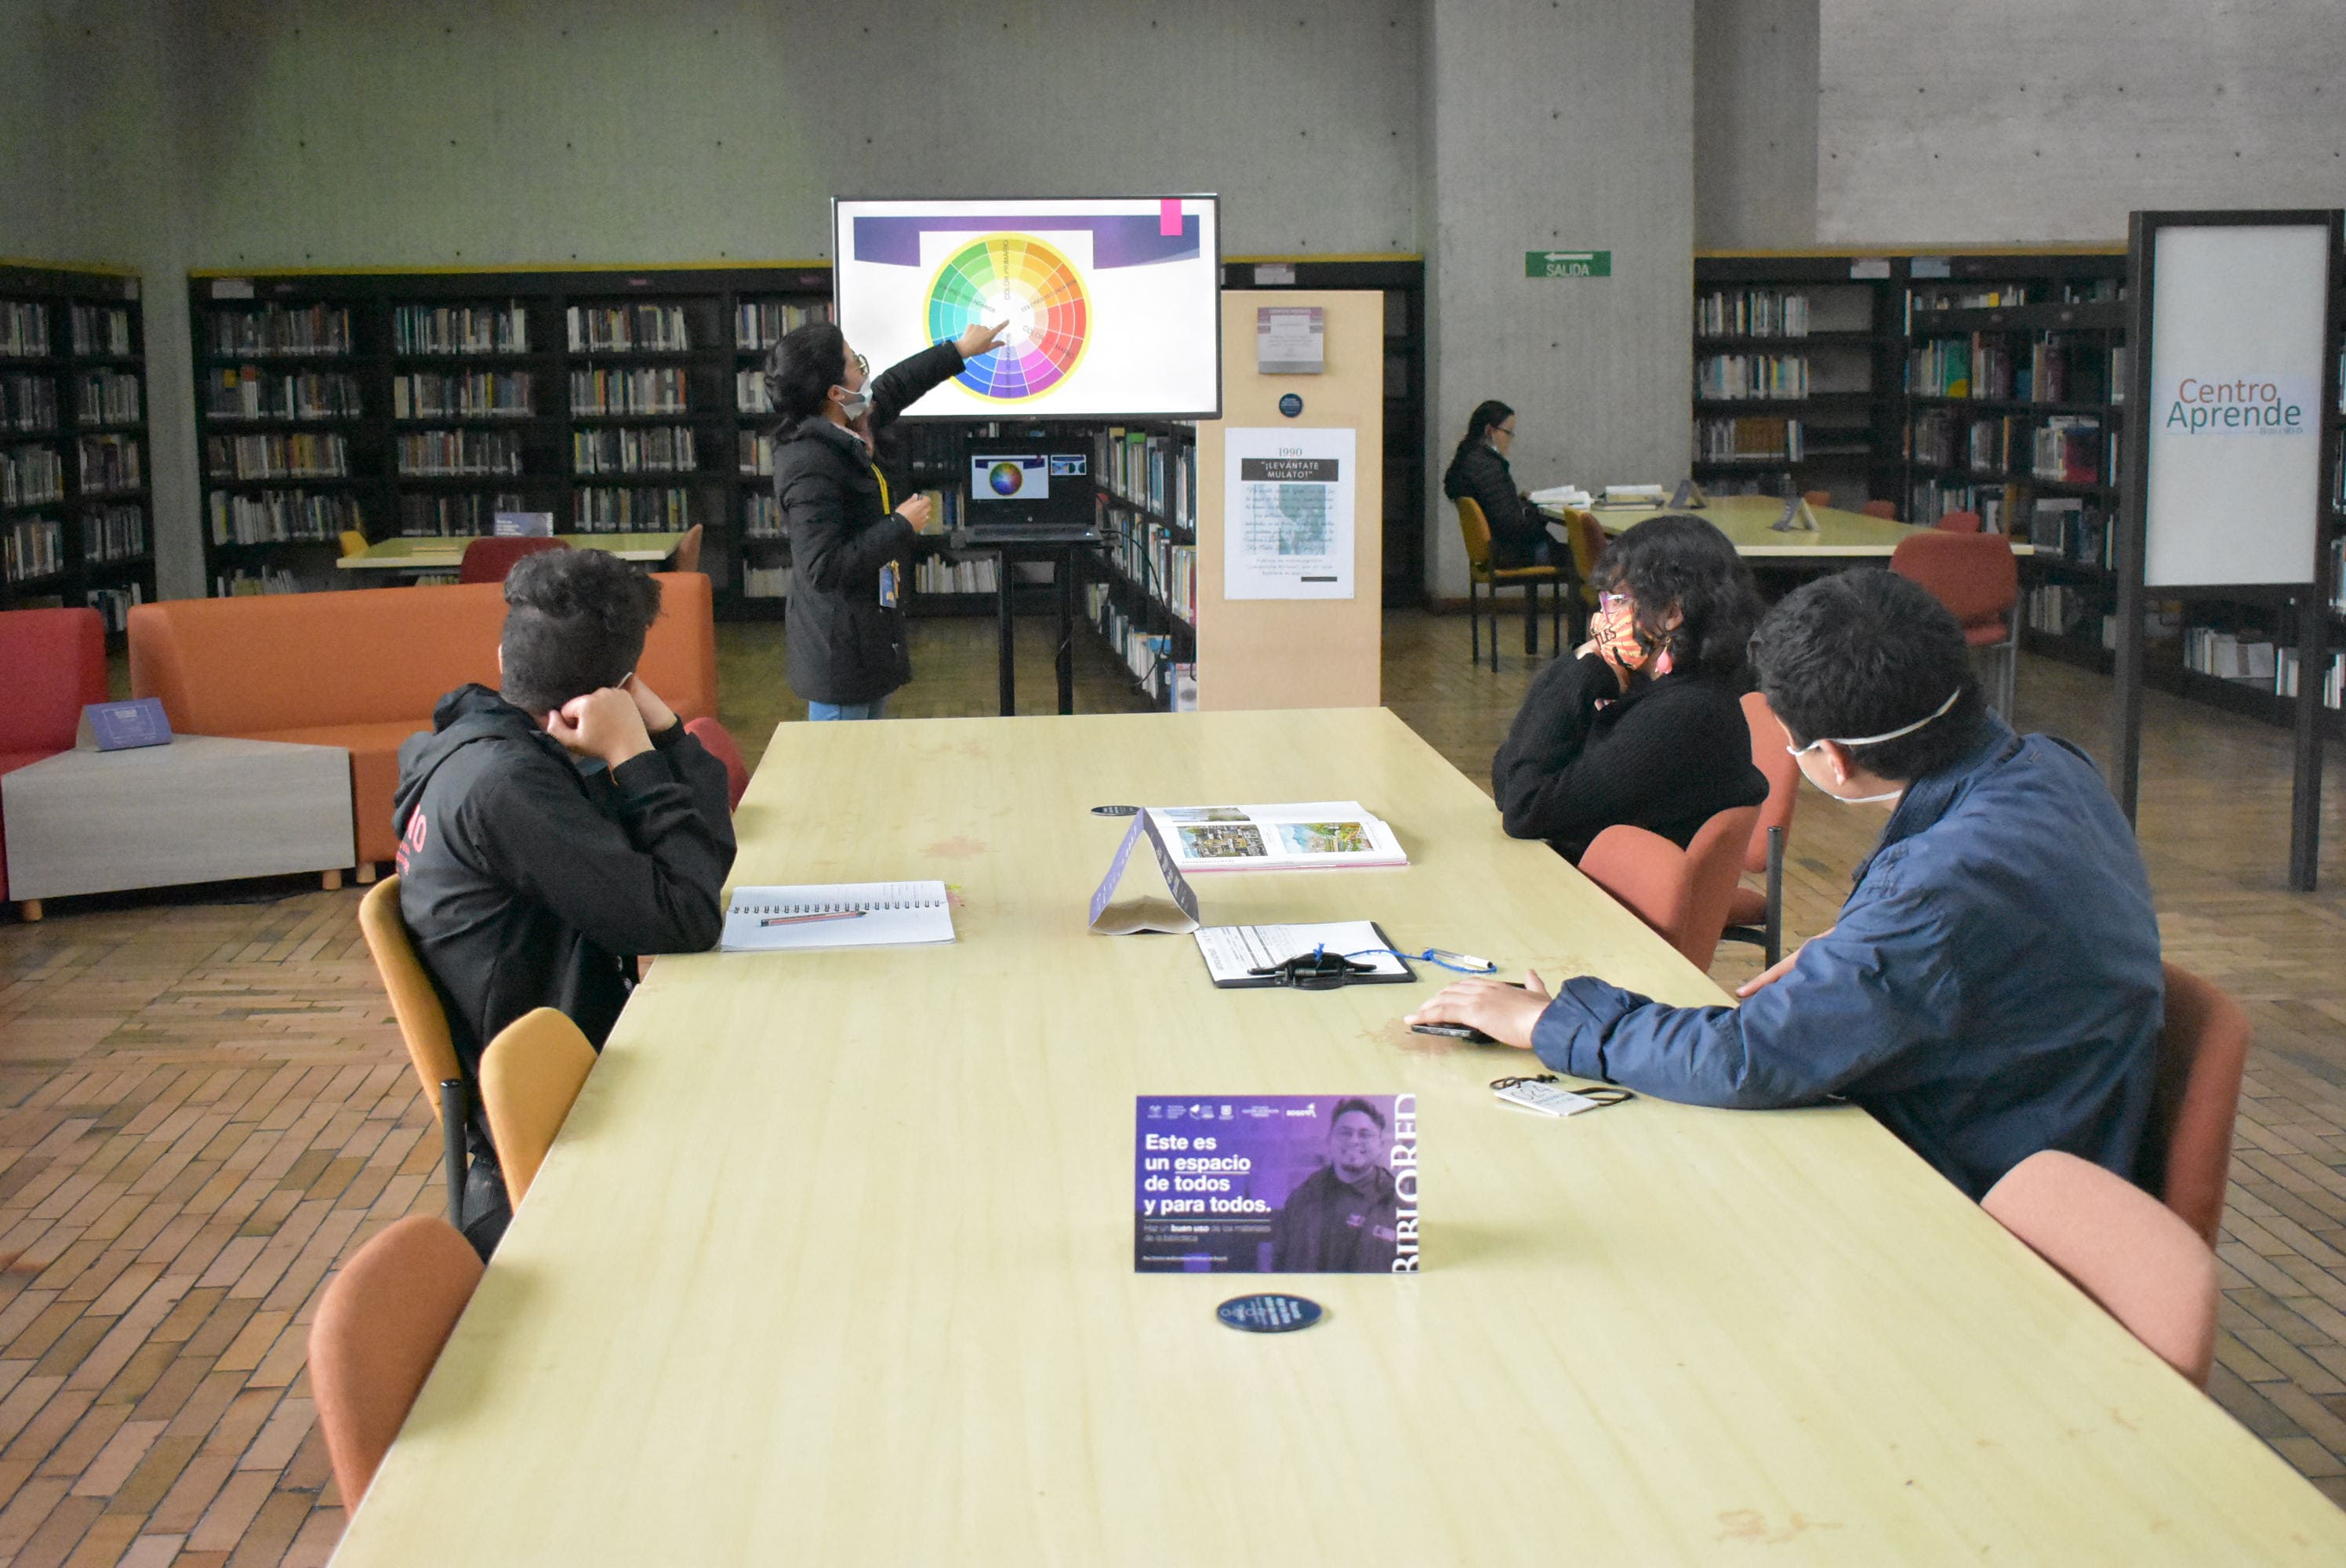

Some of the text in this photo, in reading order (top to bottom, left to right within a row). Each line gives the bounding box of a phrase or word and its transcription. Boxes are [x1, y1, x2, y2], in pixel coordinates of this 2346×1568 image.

[1546, 263, 1590, 277] SALIDA
[2179, 379, 2277, 404] Centro
[2166, 397, 2301, 434] Aprende
[1279, 448, 1302, 457] 1990
[1146, 1134, 1217, 1151] Este es
[1145, 1154, 1251, 1174] un espacio
[1144, 1174, 1231, 1192] de todos
[1143, 1196, 1272, 1216] y para todos.
